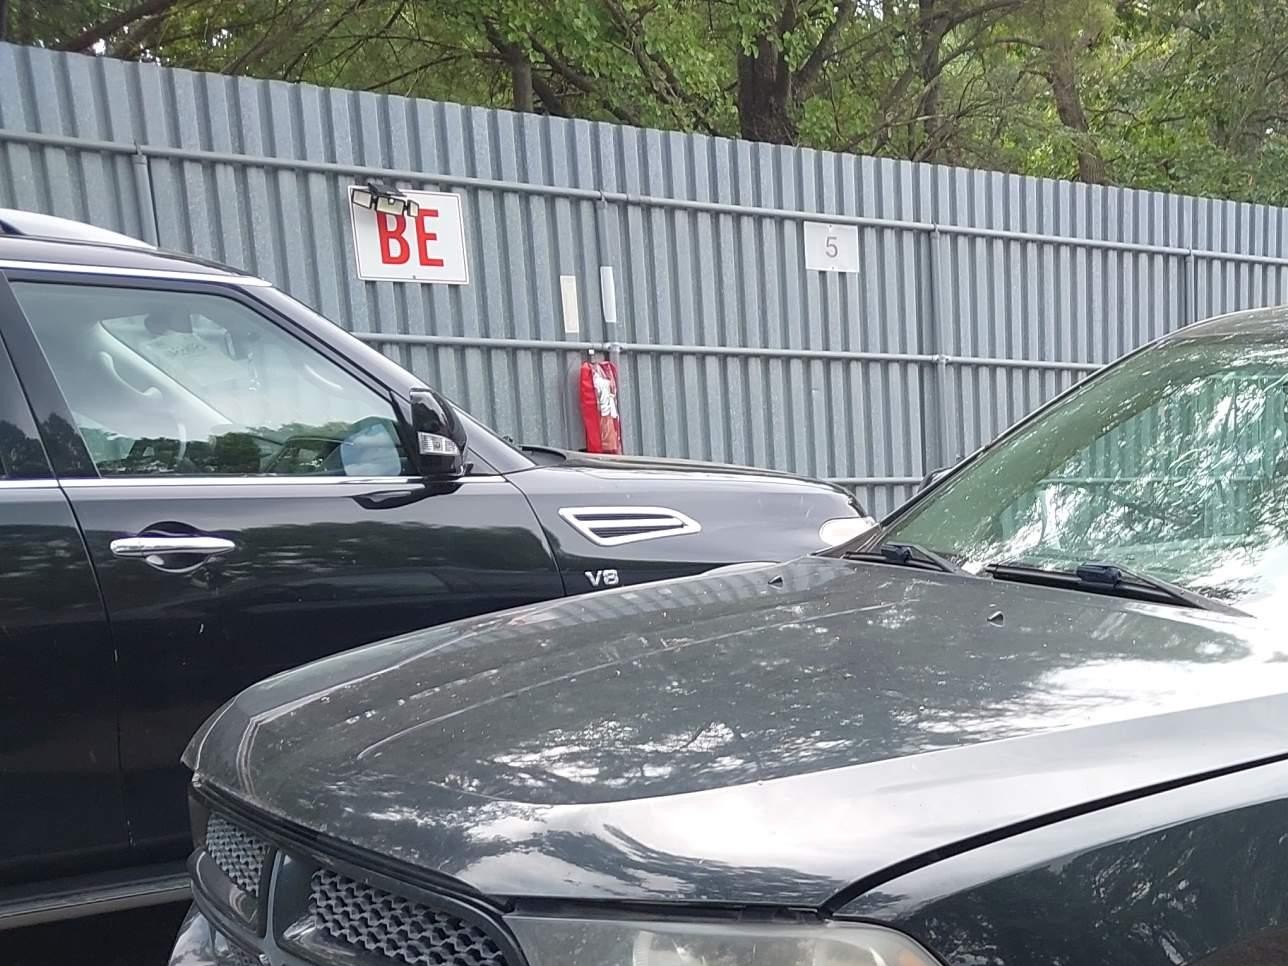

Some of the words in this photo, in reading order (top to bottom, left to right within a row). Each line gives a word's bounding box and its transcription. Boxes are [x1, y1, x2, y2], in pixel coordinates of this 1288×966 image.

[376, 207, 444, 267] BE
[826, 236, 838, 258] 5
[584, 569, 619, 587] V8
